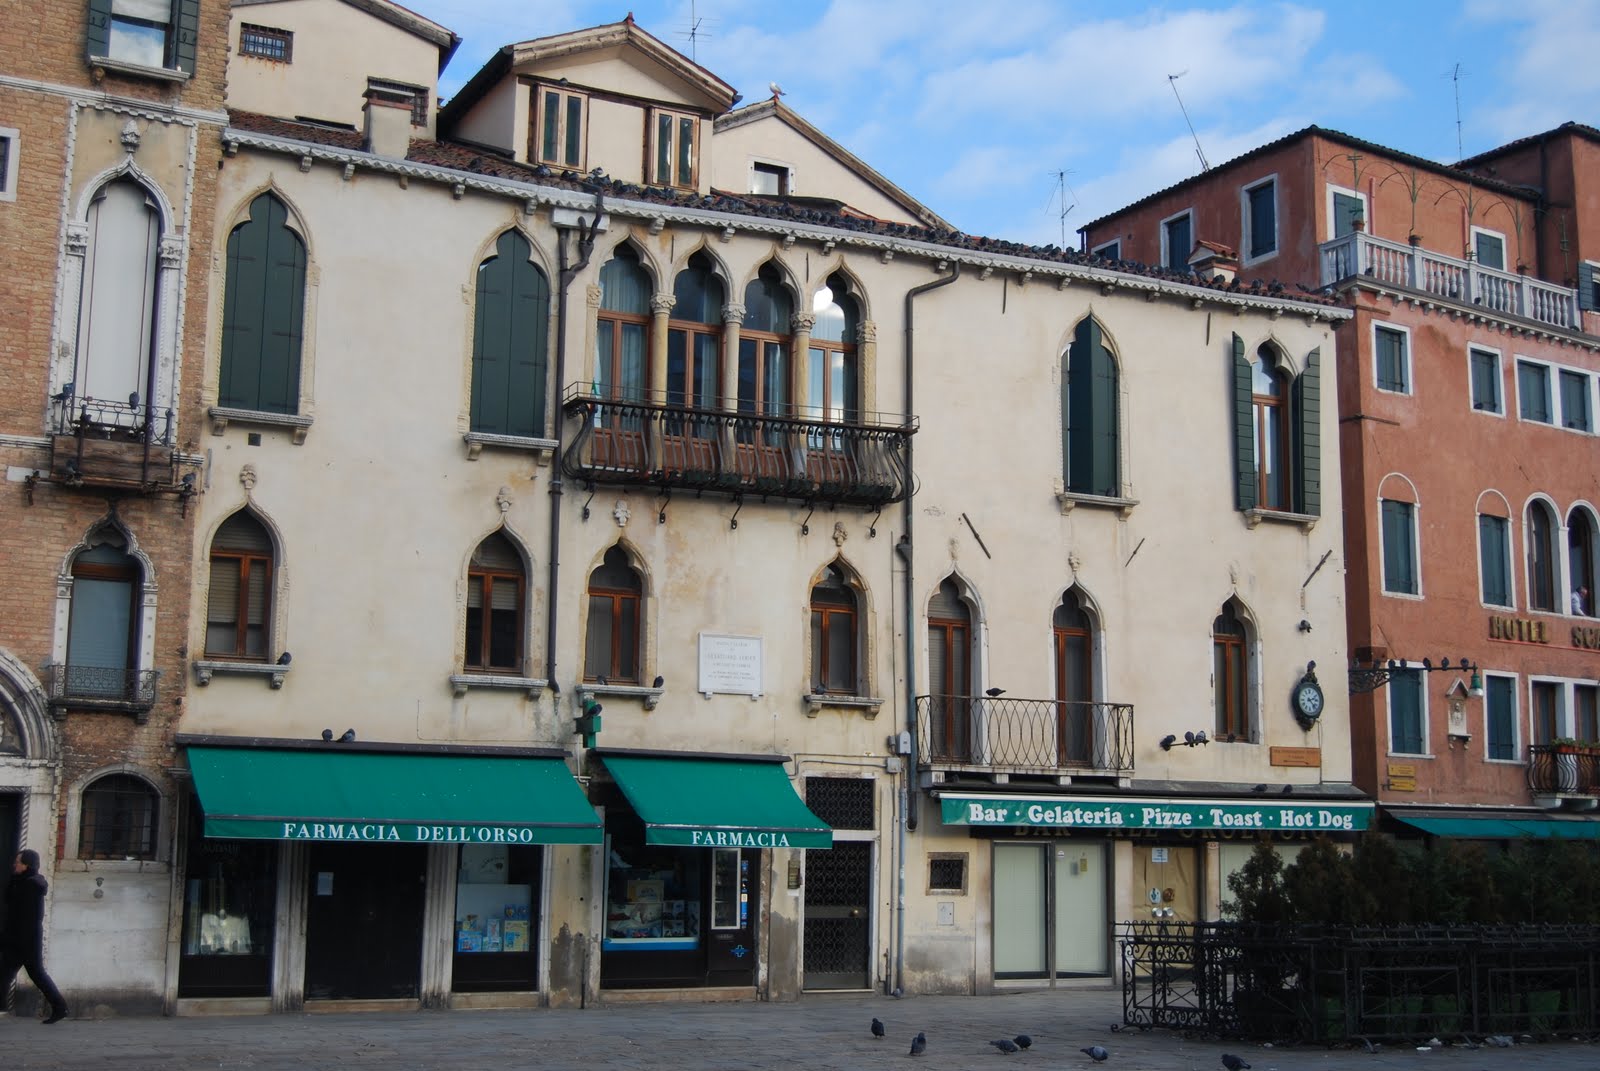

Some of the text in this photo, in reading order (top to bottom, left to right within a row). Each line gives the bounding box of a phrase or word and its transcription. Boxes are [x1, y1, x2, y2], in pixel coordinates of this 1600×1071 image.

[1489, 616, 1549, 644] HOTEL
[969, 803, 1353, 829] Bar Gelateria Pizze Toast Hot Dog
[284, 823, 533, 843] FARMACIA DELL'ORSO
[692, 831, 790, 847] FARMACIA
